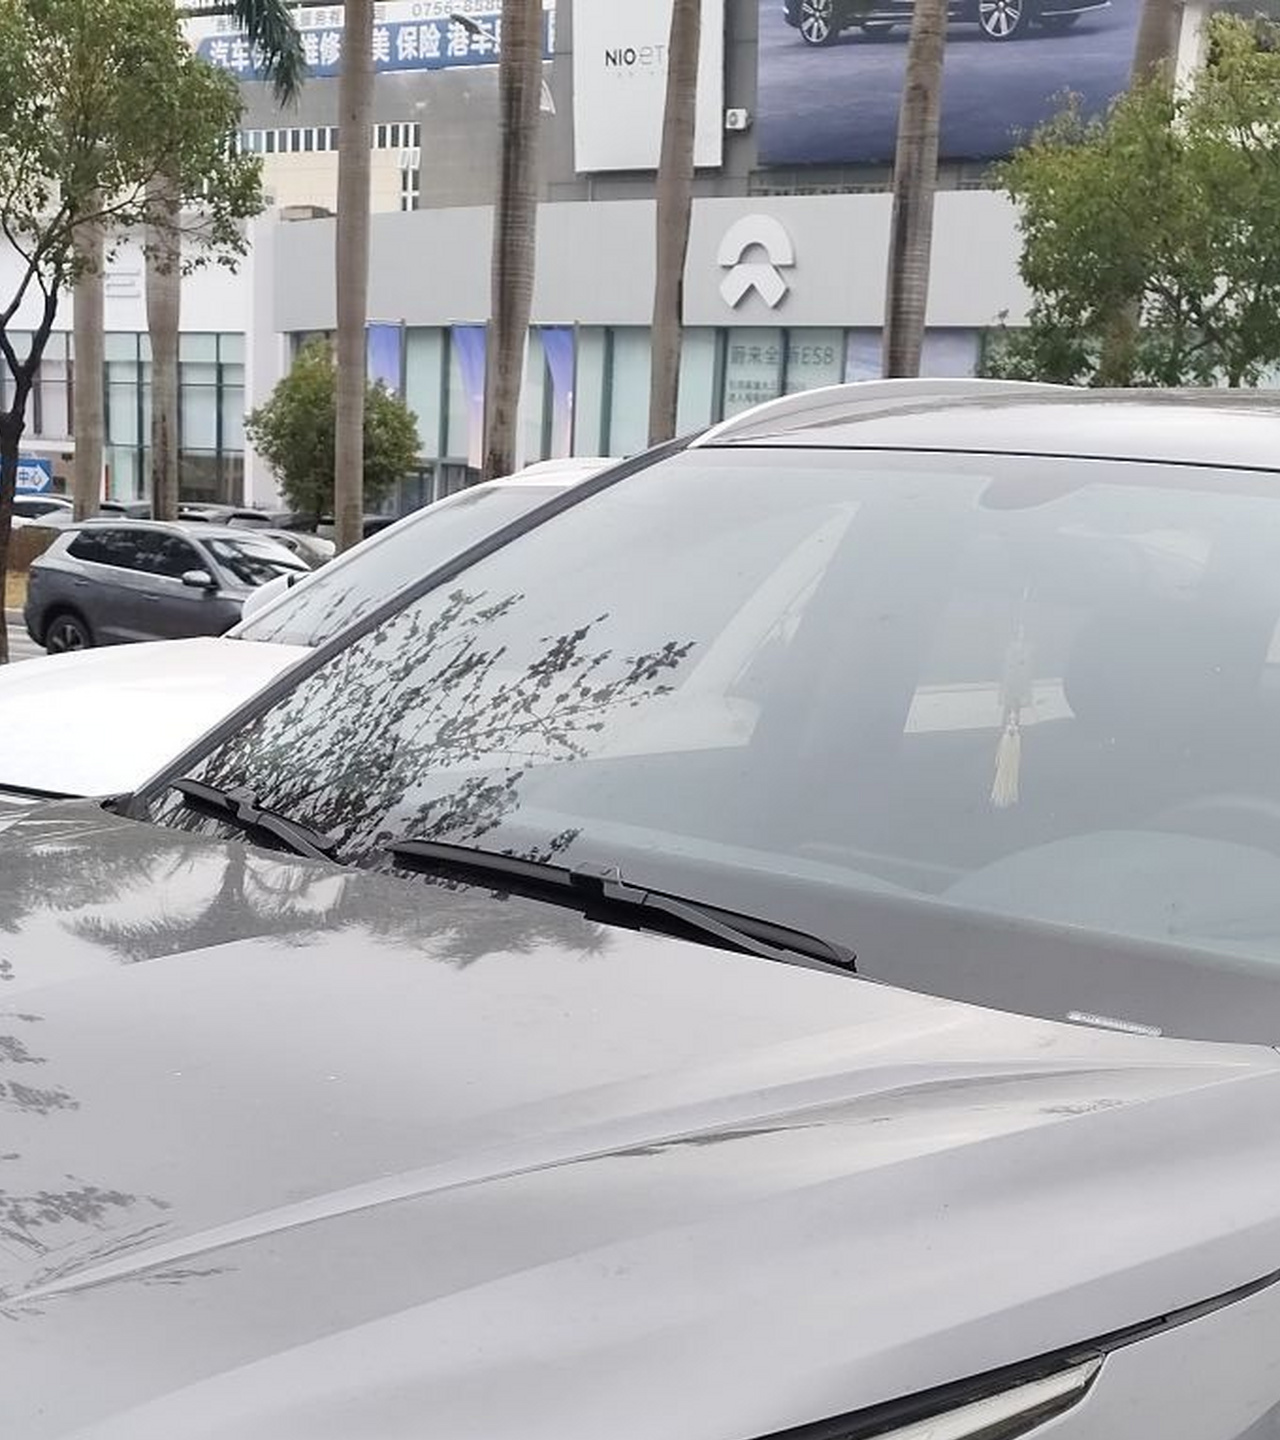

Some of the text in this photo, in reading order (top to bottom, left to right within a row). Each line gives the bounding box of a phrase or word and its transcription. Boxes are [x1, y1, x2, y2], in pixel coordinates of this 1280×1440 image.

[396, 22, 441, 60] 保险
[447, 18, 500, 57] 港车
[605, 48, 636, 66] NIO
